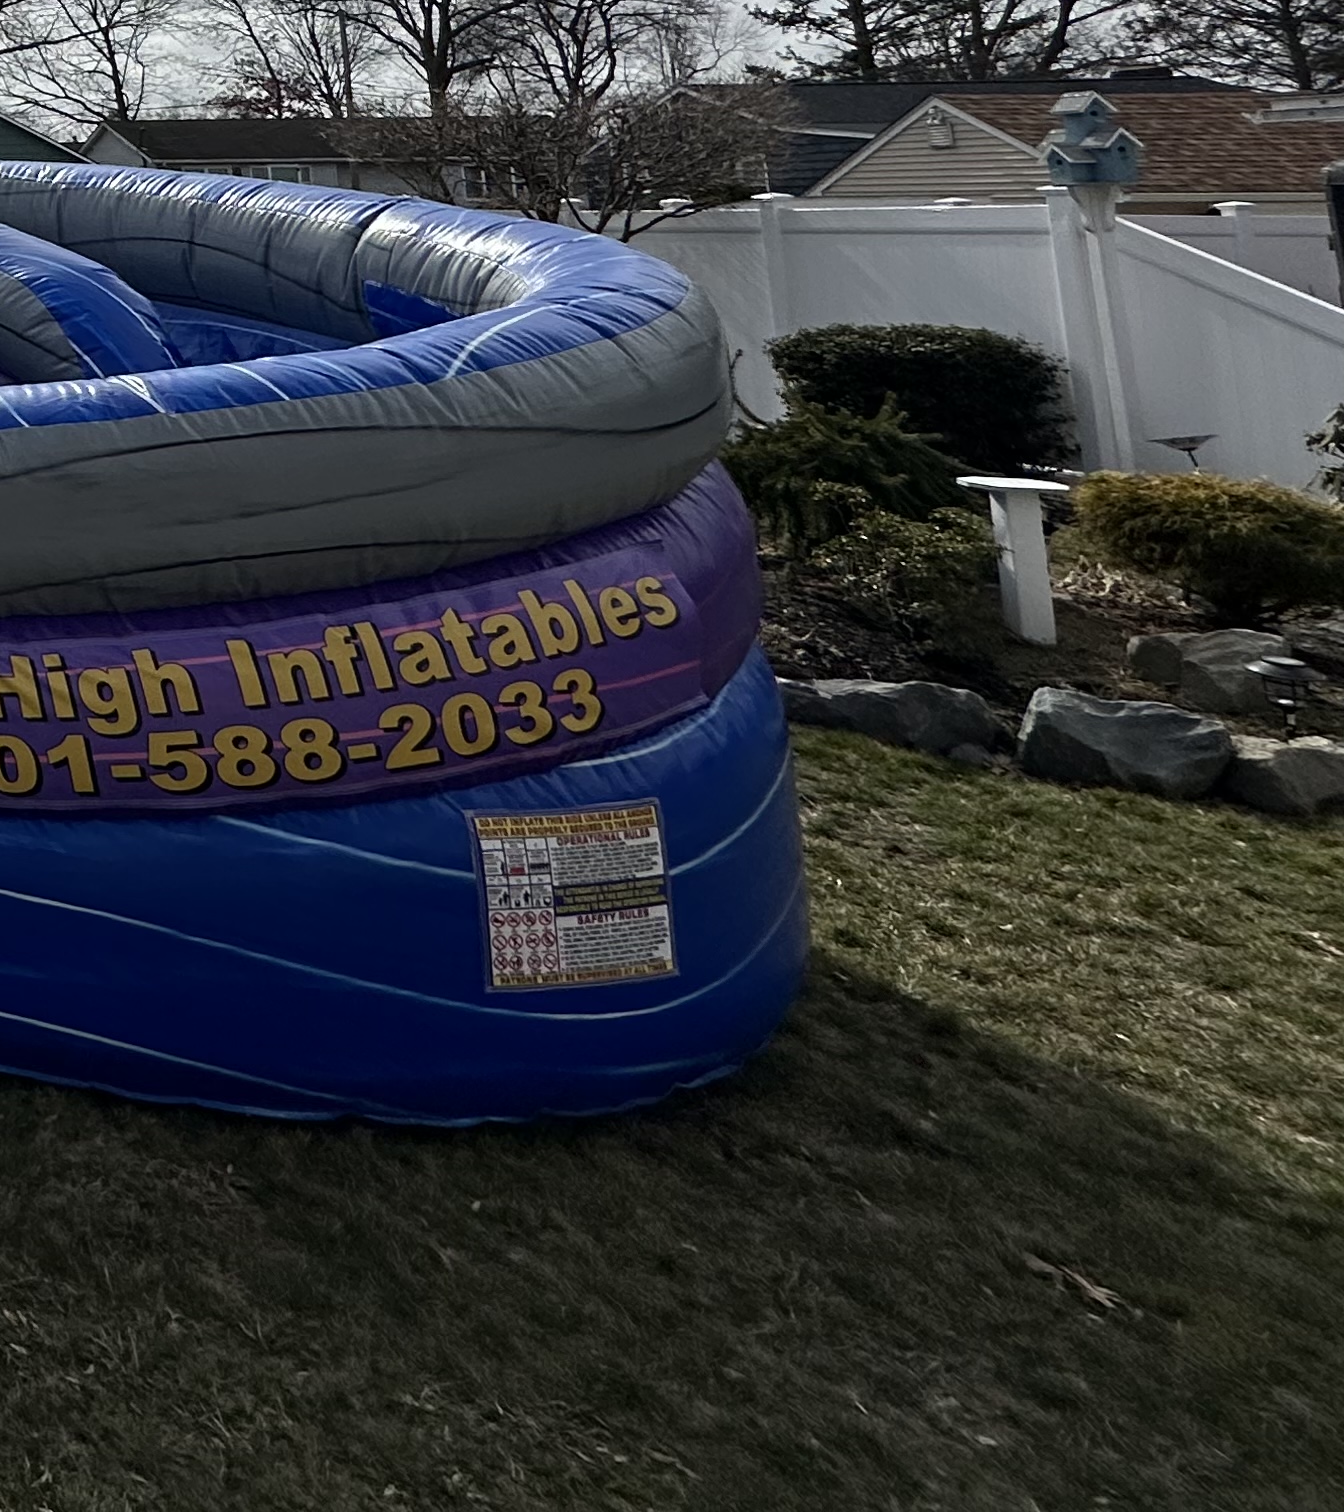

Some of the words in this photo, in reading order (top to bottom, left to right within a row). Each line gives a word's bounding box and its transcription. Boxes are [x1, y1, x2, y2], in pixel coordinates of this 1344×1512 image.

[225, 575, 680, 708] Inflatables
[556, 831, 623, 846] OPERATIONAL
[624, 828, 650, 840] RULES
[577, 912, 616, 925] SAFETY
[619, 908, 649, 921] RULES
